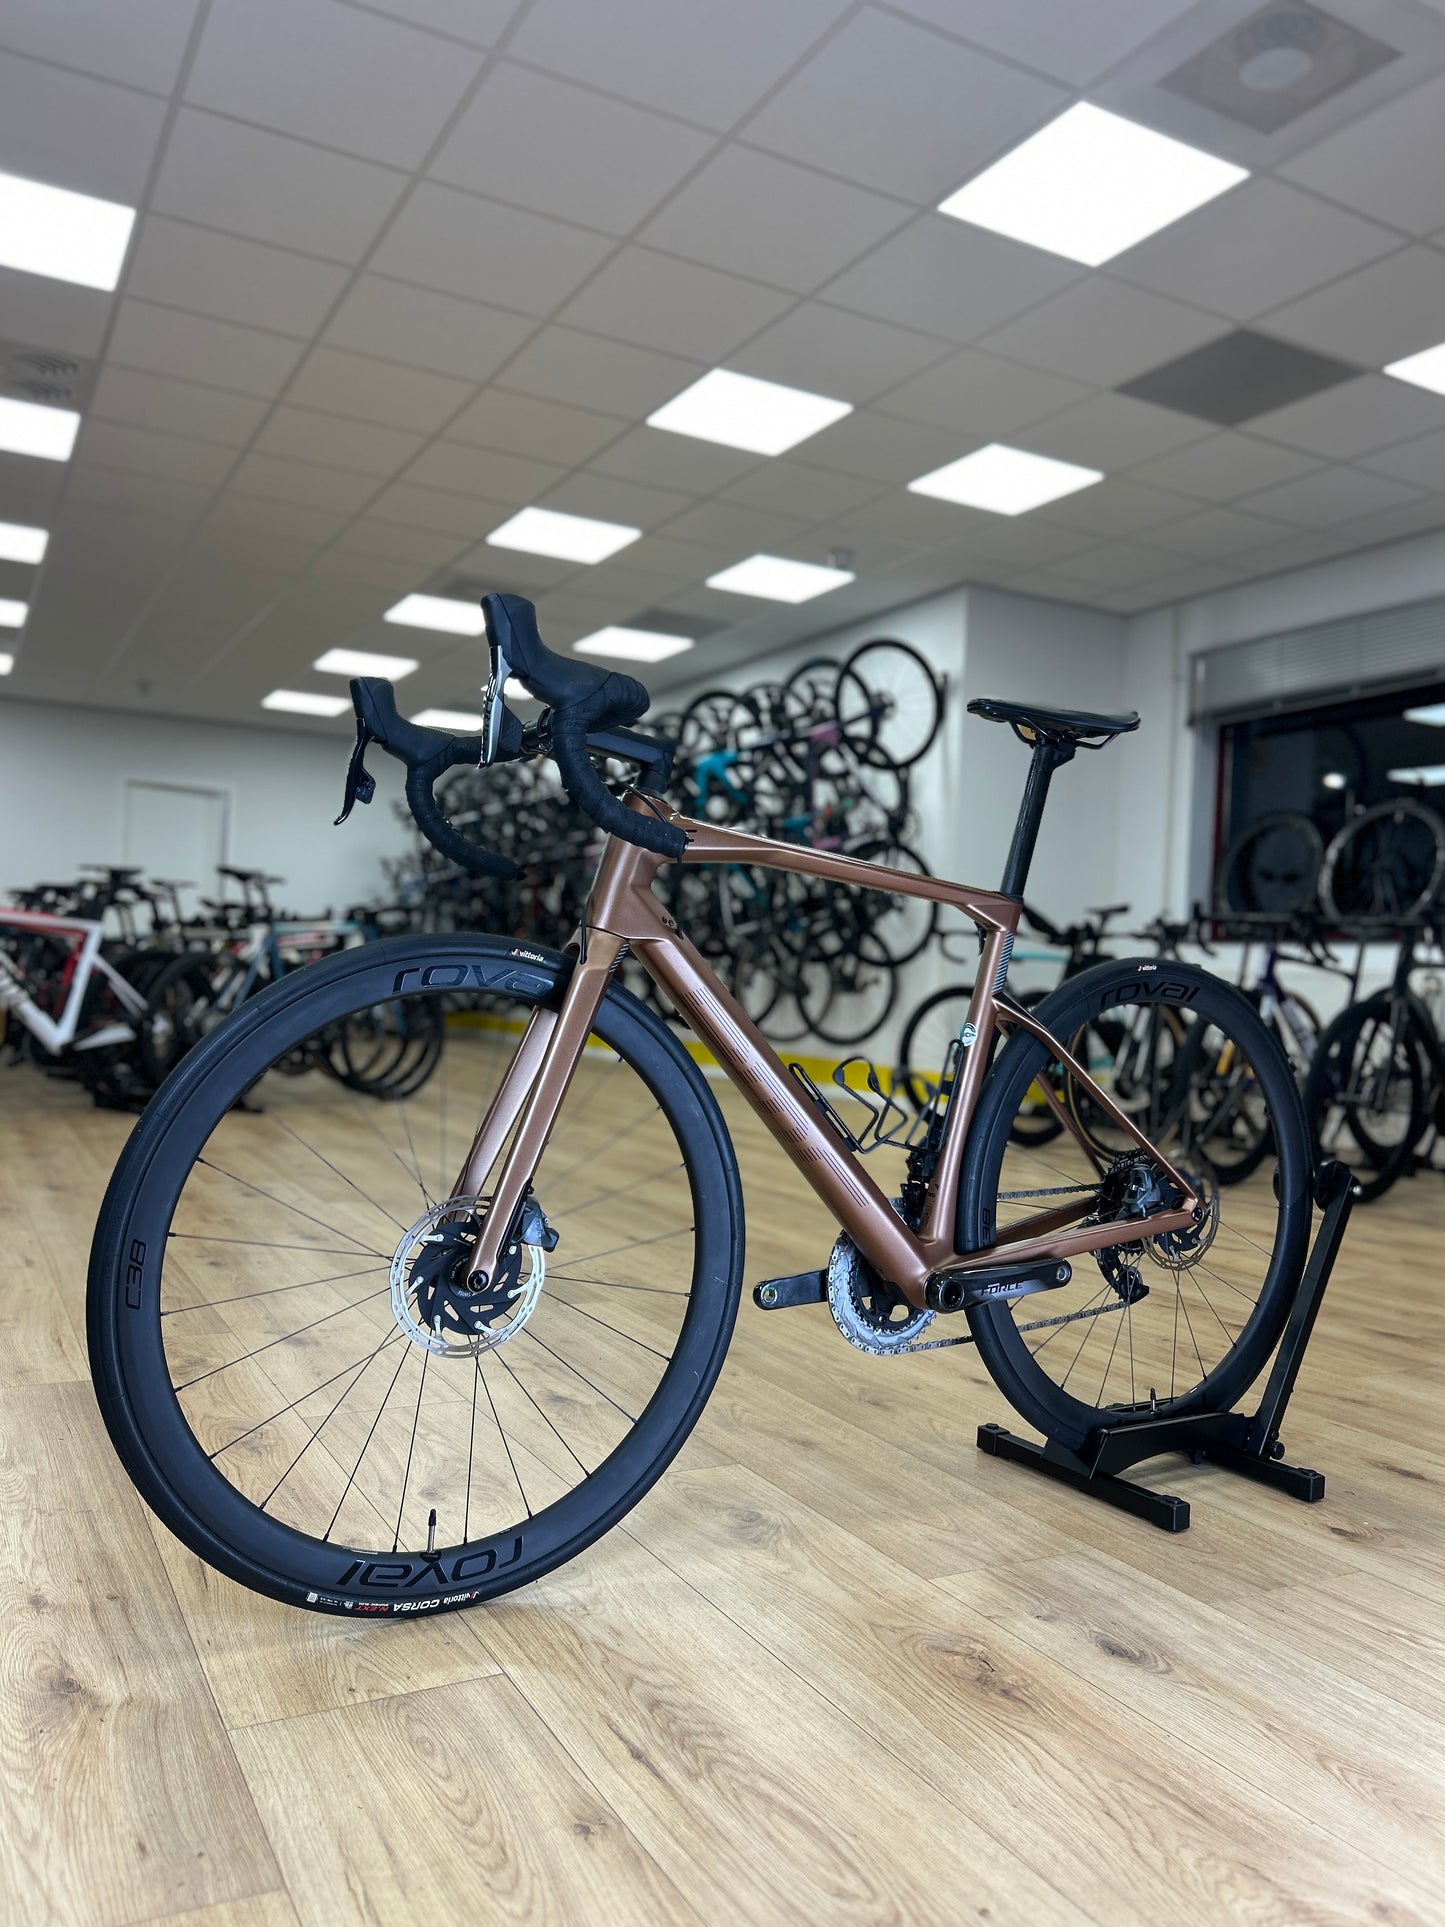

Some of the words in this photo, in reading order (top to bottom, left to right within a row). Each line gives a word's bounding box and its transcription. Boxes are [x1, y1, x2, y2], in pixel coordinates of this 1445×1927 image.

[517, 949, 544, 962] vittoria
[392, 964, 555, 1000] rova
[1100, 981, 1200, 1010] roval
[125, 1239, 147, 1310] C38
[981, 1282, 1023, 1296] FORCE
[336, 1536, 523, 1588] roval
[393, 1599, 440, 1612] CORSA
[443, 1592, 471, 1605] vittoria
